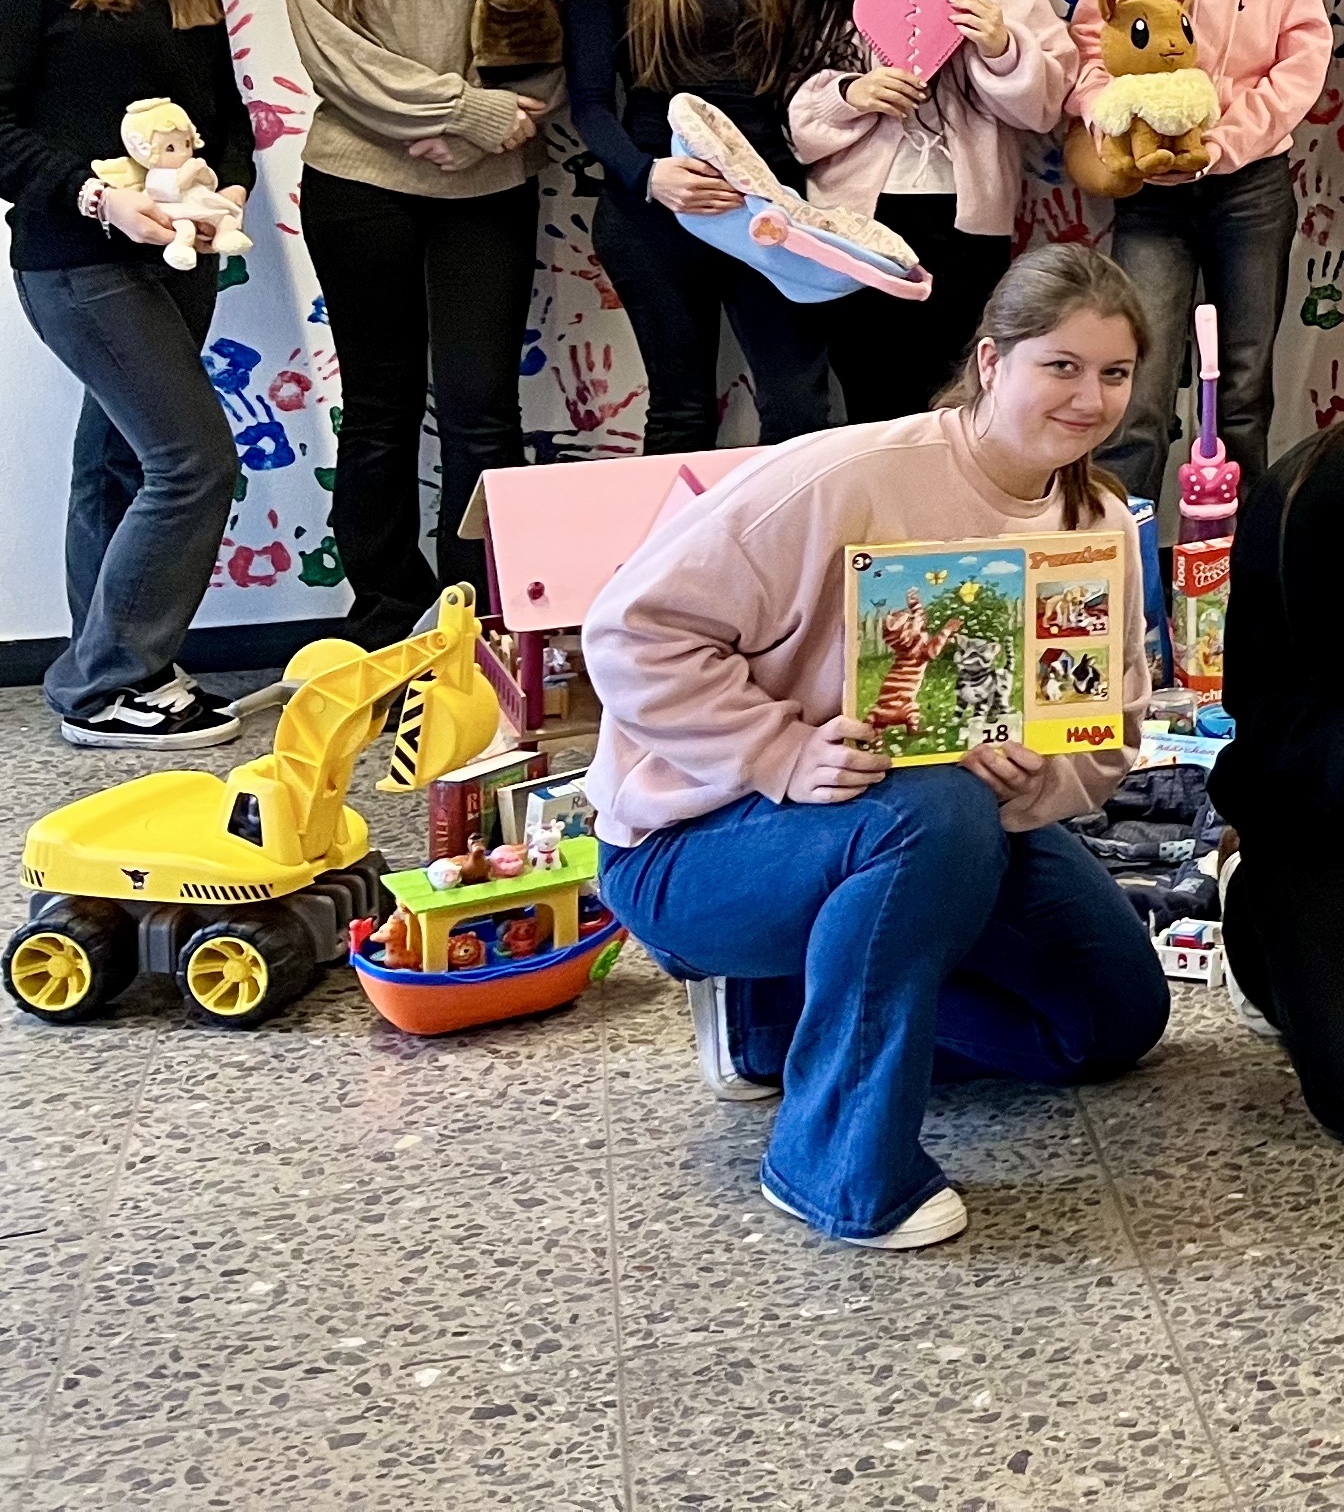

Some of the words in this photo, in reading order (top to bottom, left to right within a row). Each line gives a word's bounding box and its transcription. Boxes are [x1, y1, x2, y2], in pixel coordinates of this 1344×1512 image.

[1029, 545, 1118, 571] Puzzles
[1090, 621, 1107, 633] 12
[1094, 686, 1109, 698] 15
[982, 724, 1009, 745] 18
[1066, 725, 1116, 746] HABA
